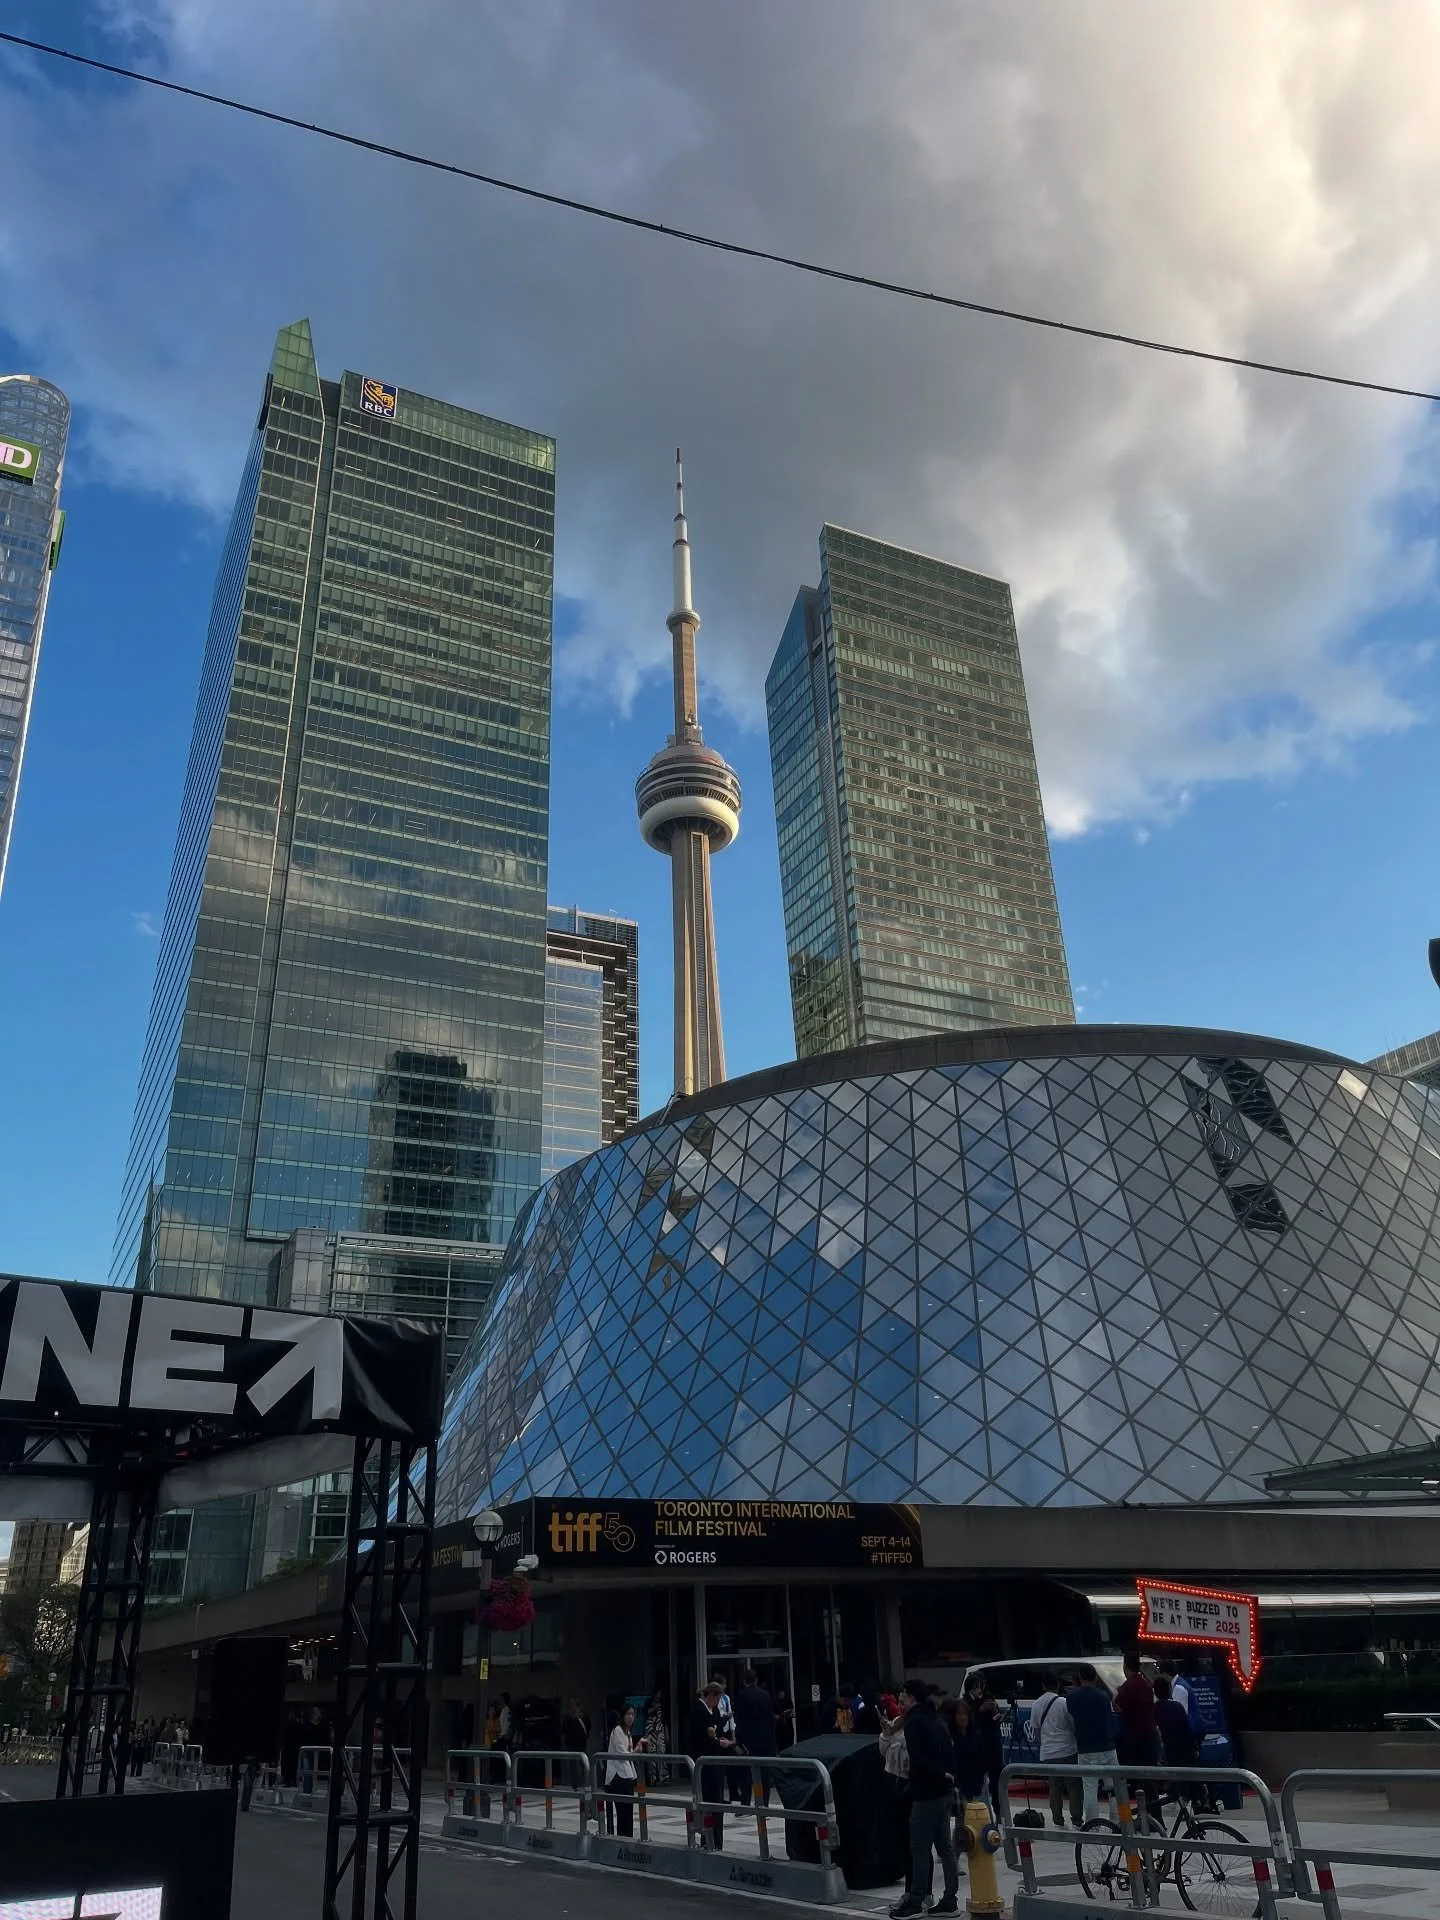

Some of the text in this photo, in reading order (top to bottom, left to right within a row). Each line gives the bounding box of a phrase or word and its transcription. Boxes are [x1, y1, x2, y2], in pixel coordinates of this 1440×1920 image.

[365, 402, 392, 416] RBC
[654, 1501, 855, 1519] TORONTO INTERNATIONAL
[548, 1511, 603, 1553] tiff
[655, 1520, 767, 1537] FILM FESTIVAL
[861, 1535, 886, 1549] SEPT
[669, 1551, 718, 1564] ROGERS
[870, 1552, 913, 1565] #TIFF50
[1151, 1597, 1238, 1618] WE'RE BUZZED TO
[1153, 1612, 1240, 1634] BE AT TIFF 2025
